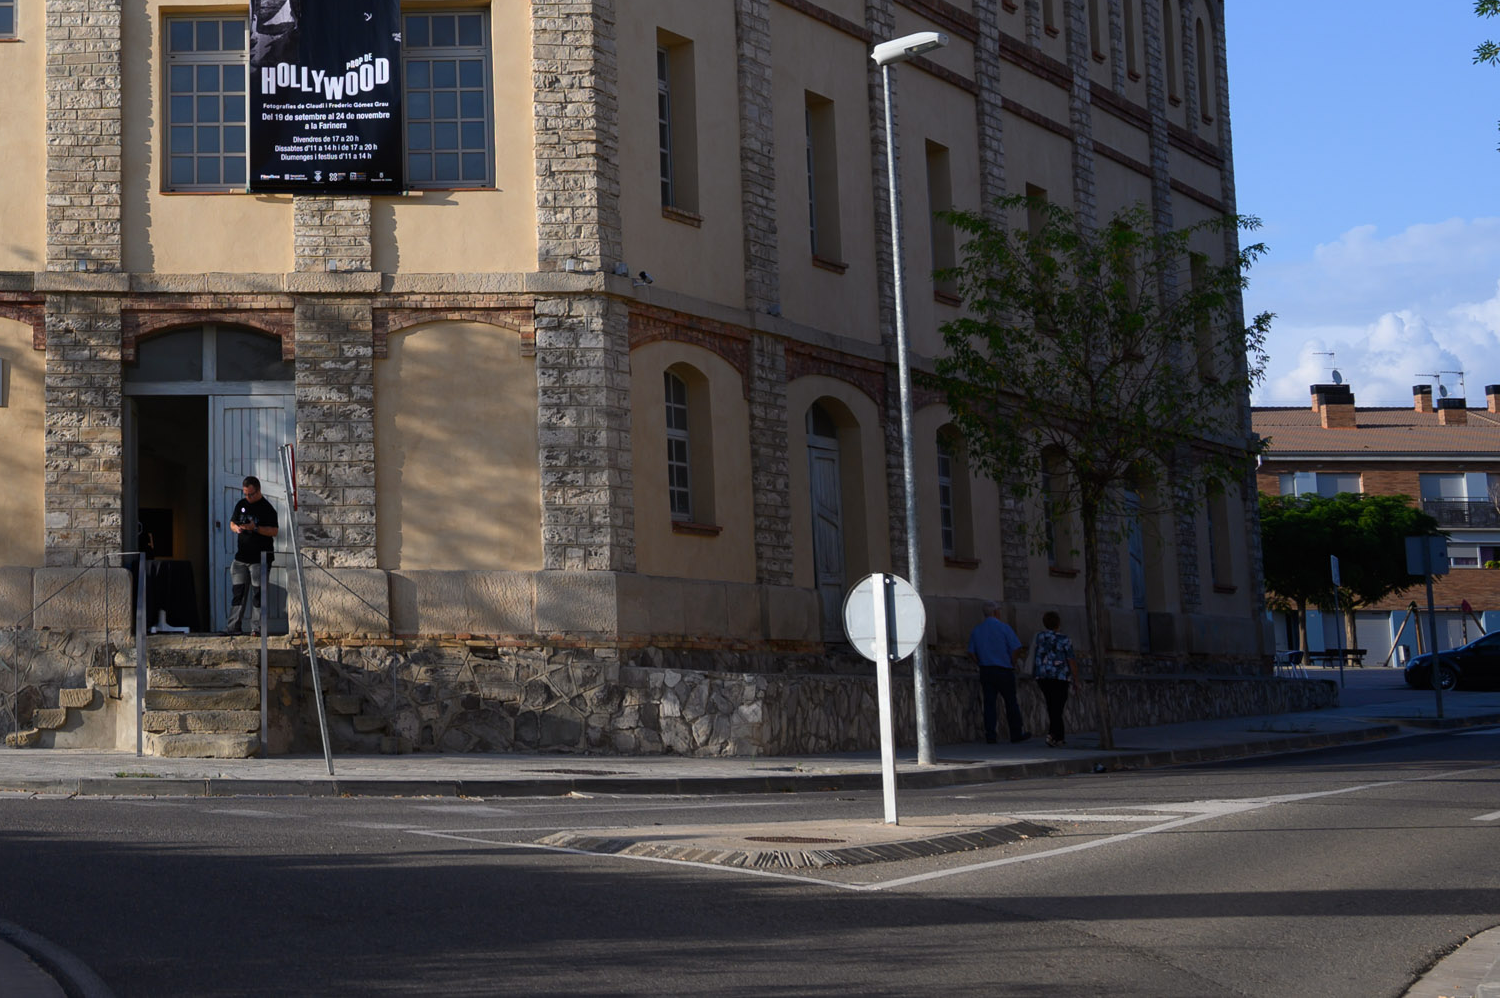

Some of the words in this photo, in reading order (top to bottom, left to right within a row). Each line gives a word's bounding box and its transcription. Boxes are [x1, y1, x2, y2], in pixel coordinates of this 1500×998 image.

[346, 57, 363, 70] PROP
[364, 53, 372, 62] DE
[261, 57, 390, 100] HOLLYWOOD
[356, 112, 390, 120] novembre
[318, 122, 347, 130] Farinera
